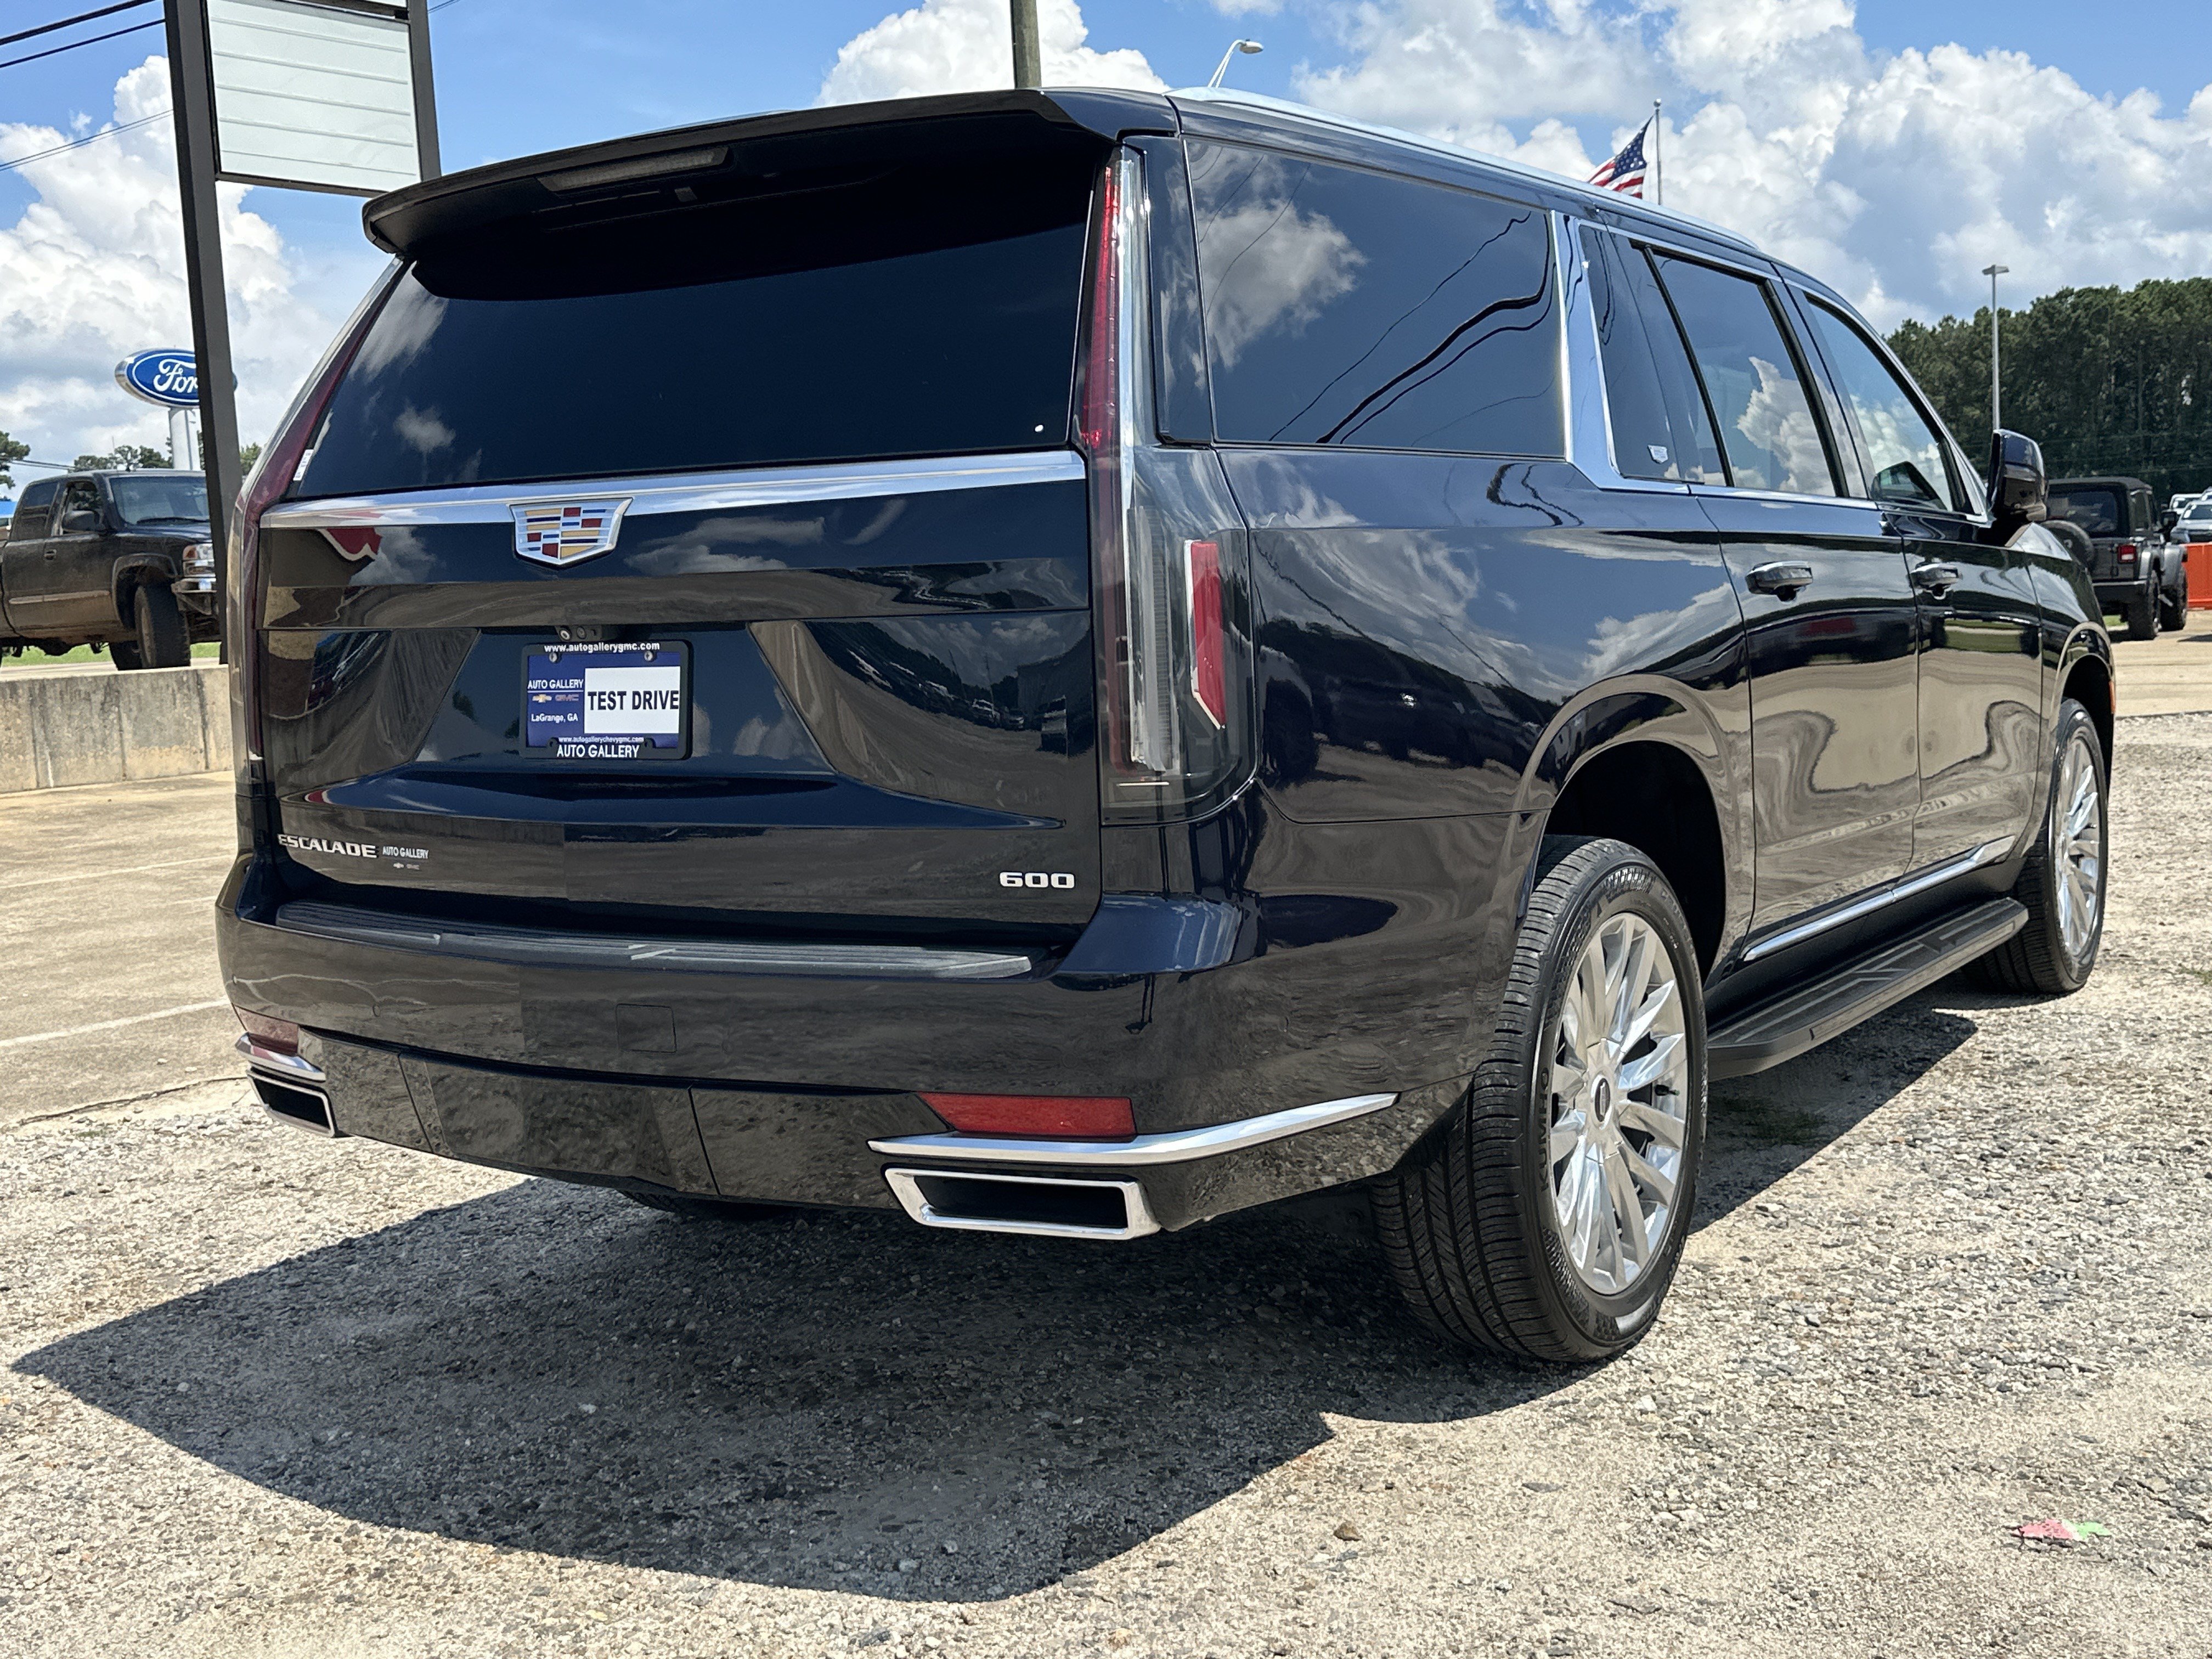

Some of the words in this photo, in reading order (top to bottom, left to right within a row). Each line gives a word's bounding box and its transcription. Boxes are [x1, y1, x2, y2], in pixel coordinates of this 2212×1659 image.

[153, 359, 199, 393] For
[544, 642, 660, 653] www.autogallerygmc.com
[527, 679, 548, 689] AUTO
[549, 679, 584, 689] GALLERY
[588, 691, 627, 710] TEST
[631, 690, 679, 710] DRIVE
[531, 713, 566, 724] LaGrange,
[567, 713, 578, 721] GA
[556, 744, 585, 758] AUTO
[588, 744, 640, 758] GALLERY
[277, 833, 377, 858] ESCALADE
[382, 846, 399, 856] AUTO
[399, 847, 429, 859] GALLERY
[1000, 872, 1075, 889] 600
